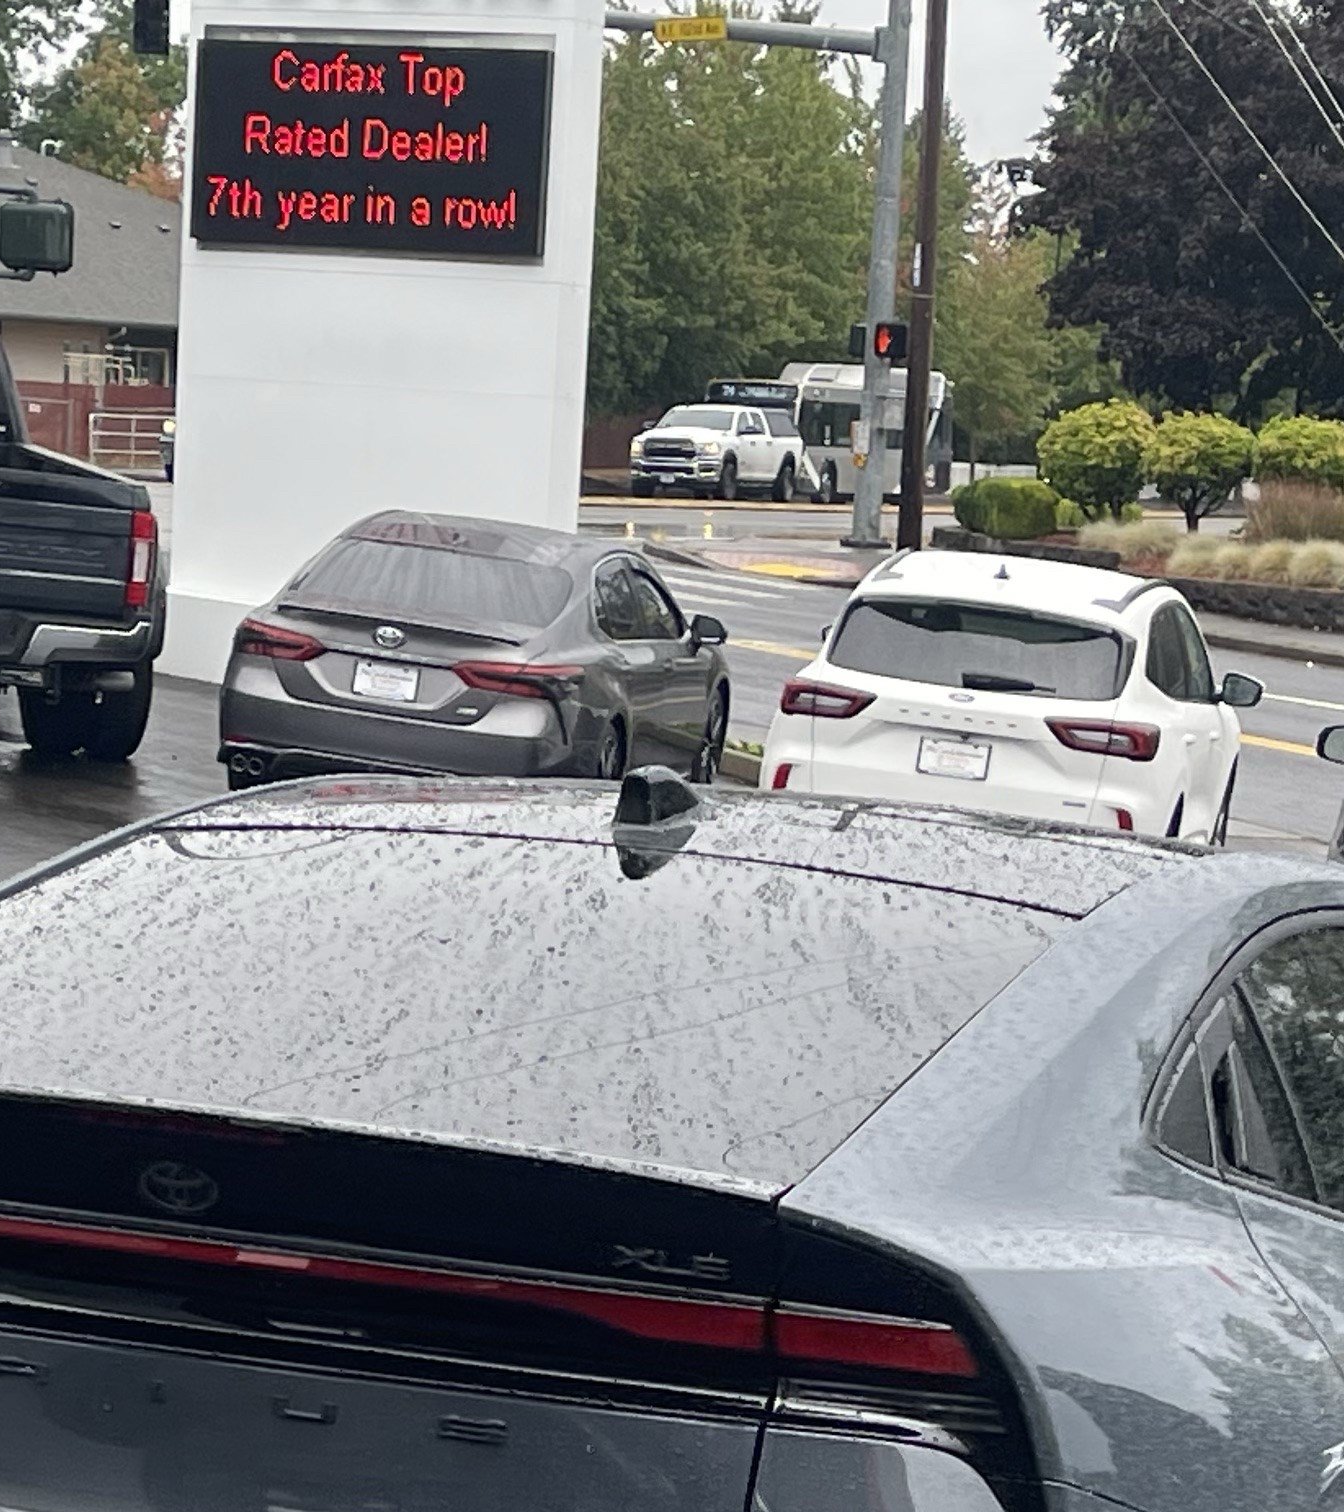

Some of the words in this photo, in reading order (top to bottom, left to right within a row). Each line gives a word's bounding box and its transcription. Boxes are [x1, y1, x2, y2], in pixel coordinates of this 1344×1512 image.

[270, 50, 386, 94] Carfax
[399, 52, 465, 107] Top
[244, 114, 349, 158] Rated
[362, 118, 488, 163] Dealer!
[208, 176, 262, 219] 7th
[276, 189, 354, 230] year
[365, 184, 396, 225] in
[410, 197, 431, 226] a
[445, 188, 516, 231] row!
[612, 1244, 730, 1280] XLE
